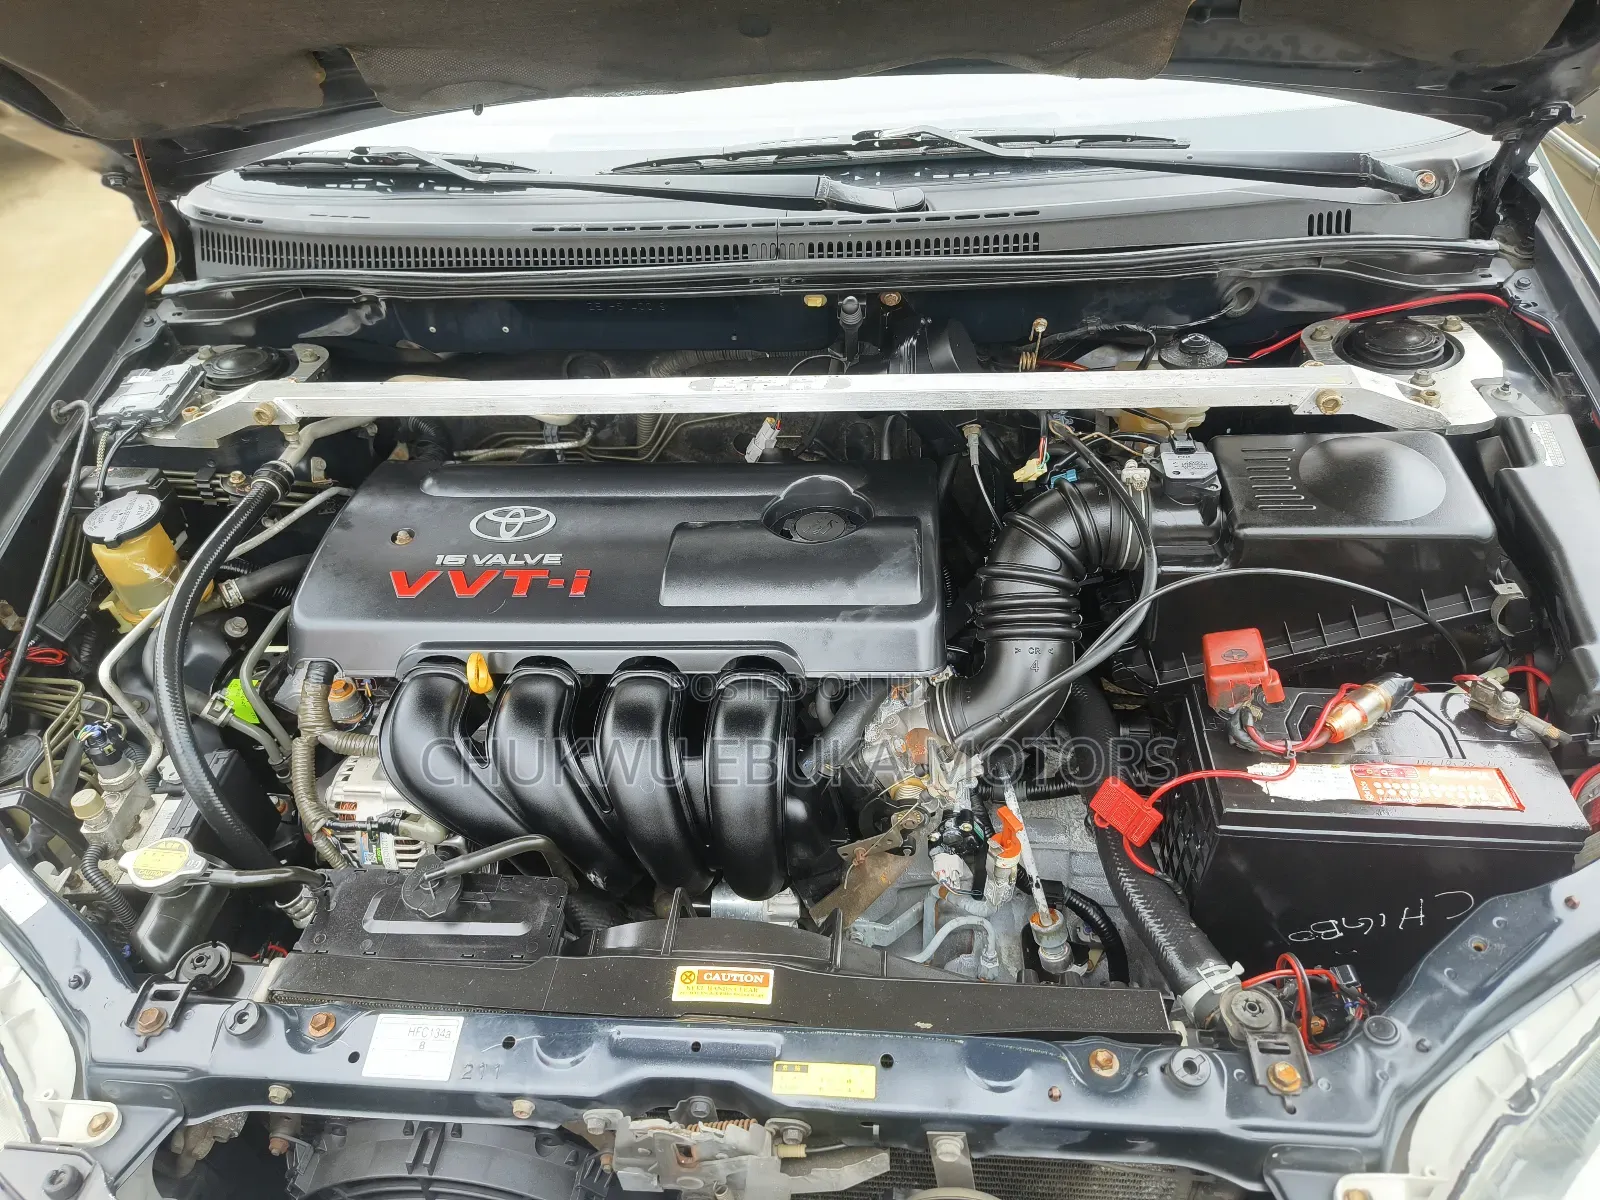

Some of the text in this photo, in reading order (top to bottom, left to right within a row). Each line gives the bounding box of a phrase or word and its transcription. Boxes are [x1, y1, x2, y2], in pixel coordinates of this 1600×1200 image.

[435, 553, 564, 567] 16 VALVE
[389, 568, 592, 598] VVT-i
[1030, 660, 1040, 672] 4
[703, 972, 765, 984] CAUTION
[407, 1026, 452, 1039] HFC134a
